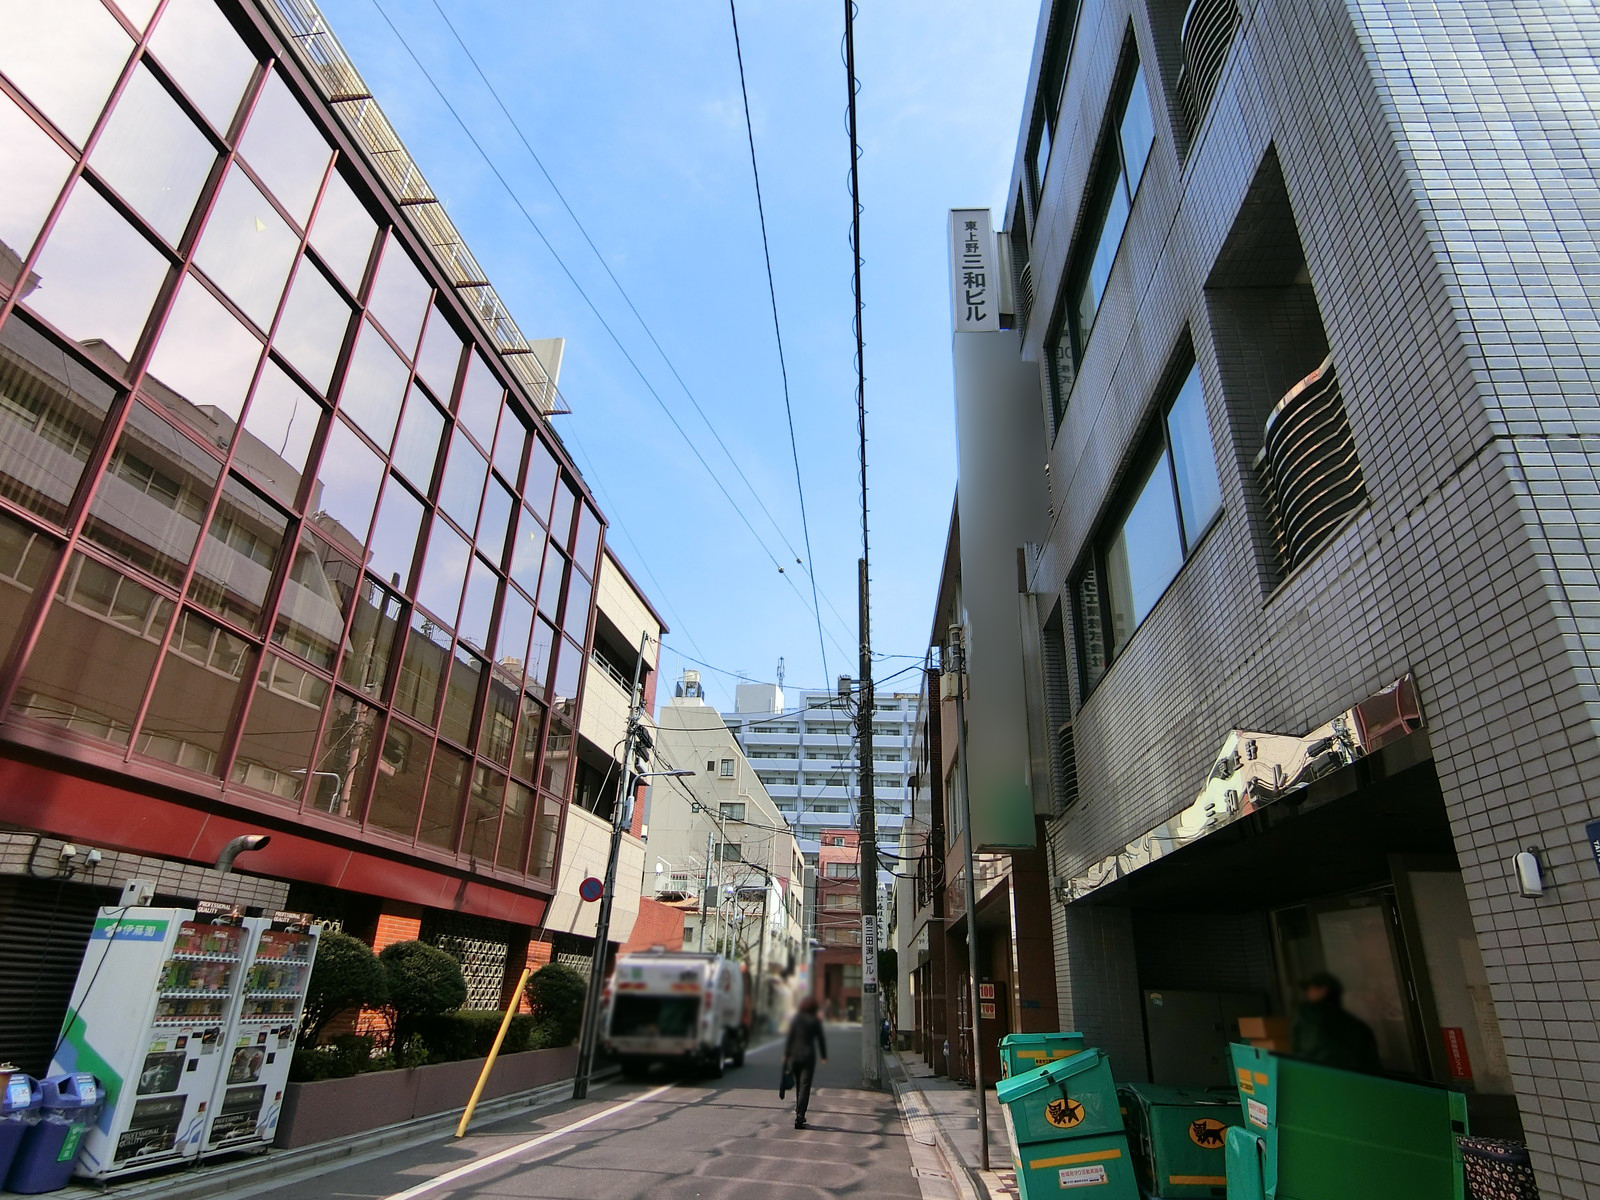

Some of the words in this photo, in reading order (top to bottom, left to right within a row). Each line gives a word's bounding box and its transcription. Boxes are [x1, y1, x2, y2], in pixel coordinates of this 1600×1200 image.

[962, 220, 987, 322] 東上野三和ビル
[979, 985, 994, 997] 100
